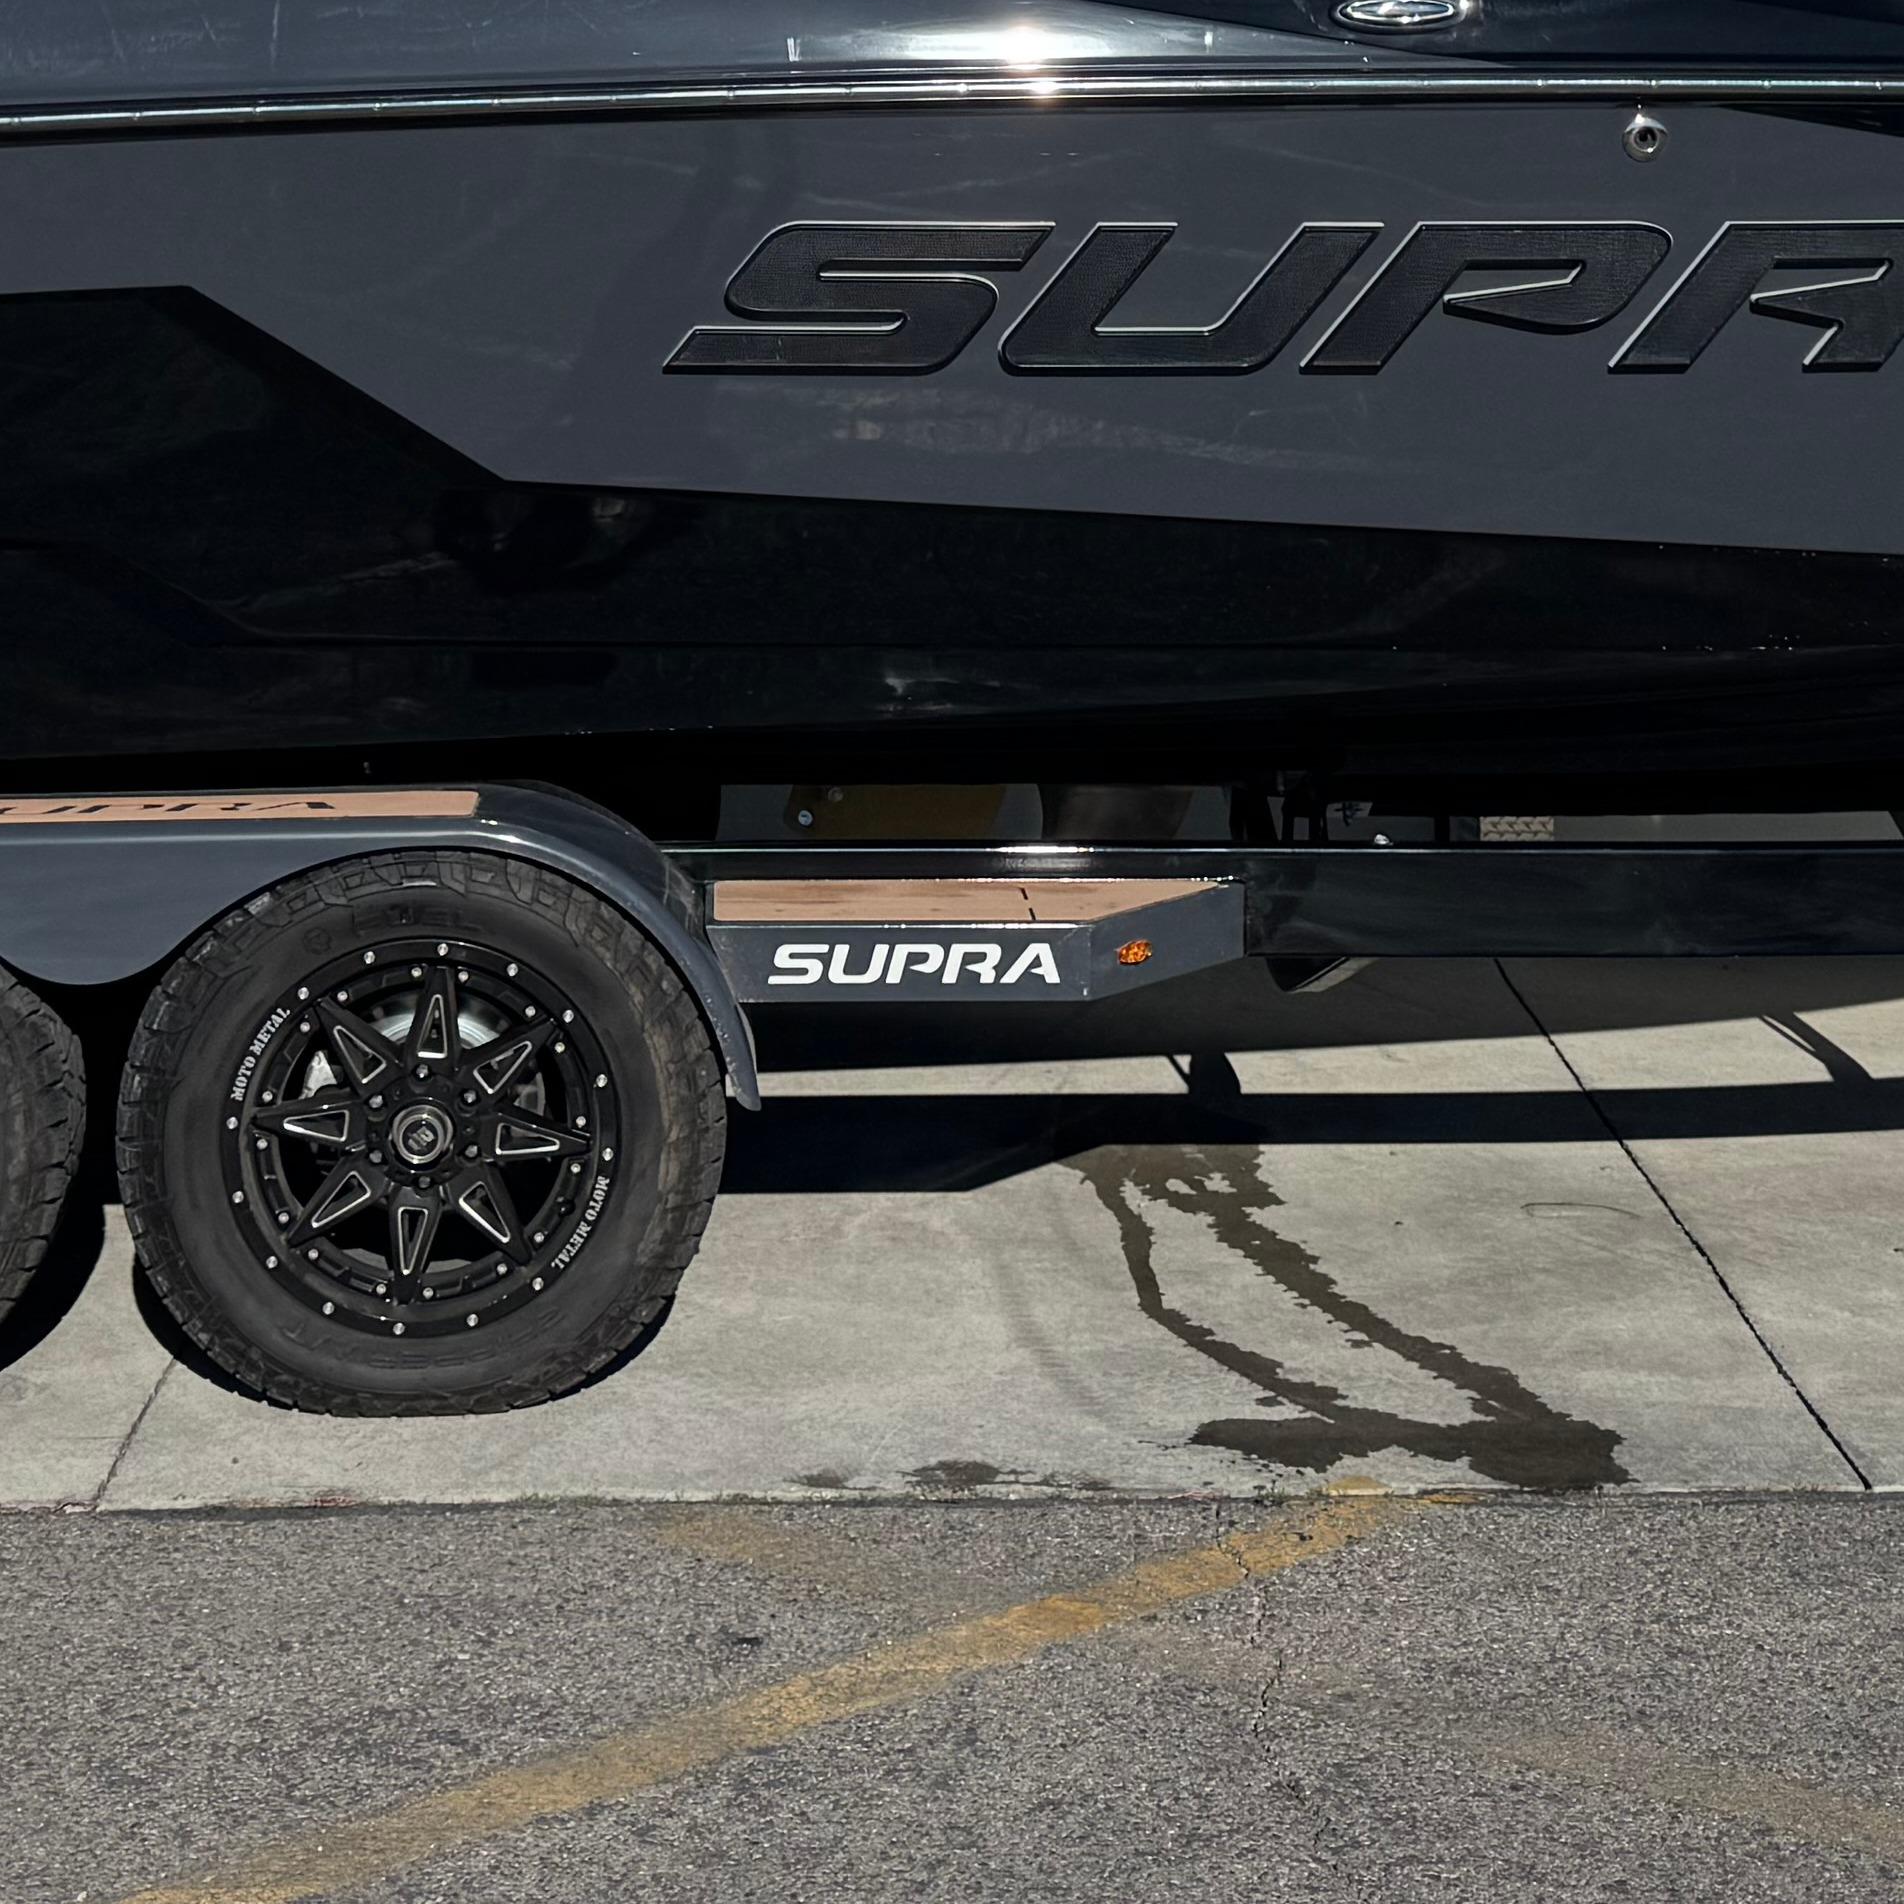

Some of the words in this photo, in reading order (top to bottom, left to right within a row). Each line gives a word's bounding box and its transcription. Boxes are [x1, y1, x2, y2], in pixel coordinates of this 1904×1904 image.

[767, 943, 1061, 985] SUPRA
[230, 1056, 256, 1102] MOTO
[249, 1007, 291, 1056] METAL
[584, 1176, 610, 1221] MOTO
[551, 1221, 592, 1269] METAL
